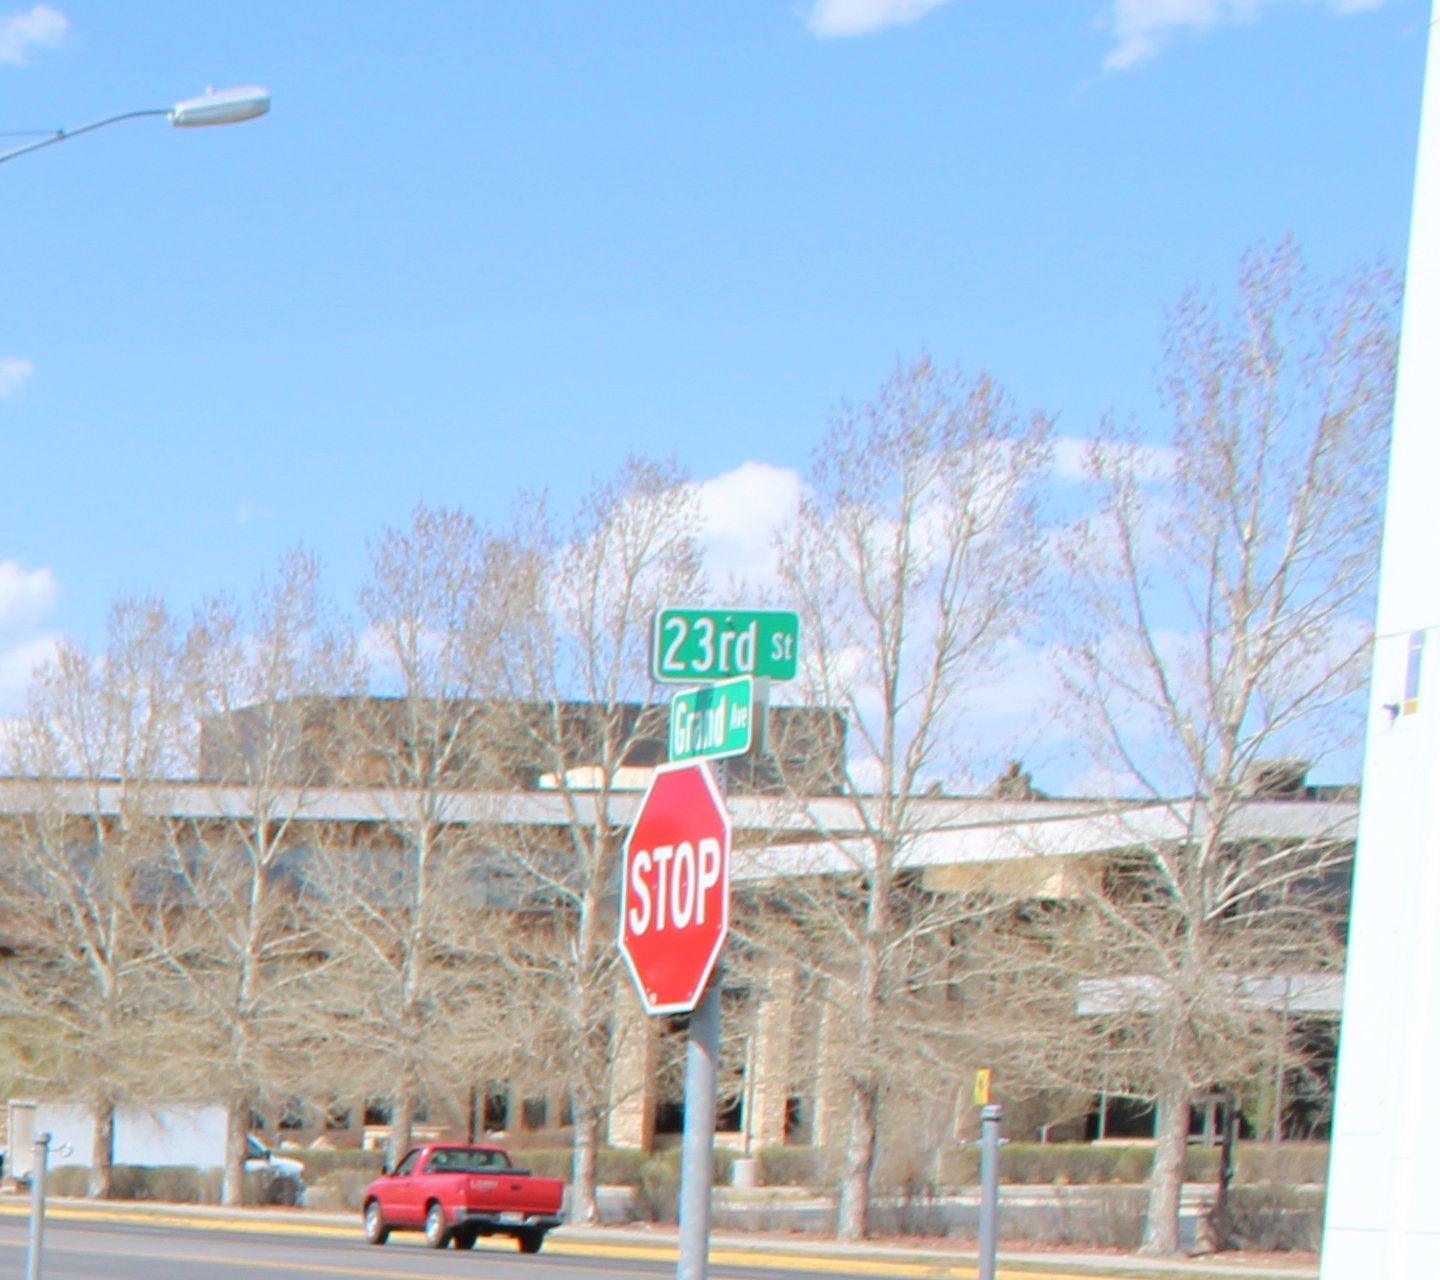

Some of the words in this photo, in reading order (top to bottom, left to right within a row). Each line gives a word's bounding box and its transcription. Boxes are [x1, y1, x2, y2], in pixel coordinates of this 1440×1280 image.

[662, 616, 759, 673] 23rd
[770, 631, 794, 661] St
[674, 693, 727, 756] Grand
[729, 702, 748, 731] Ave
[629, 837, 721, 937] STOP
